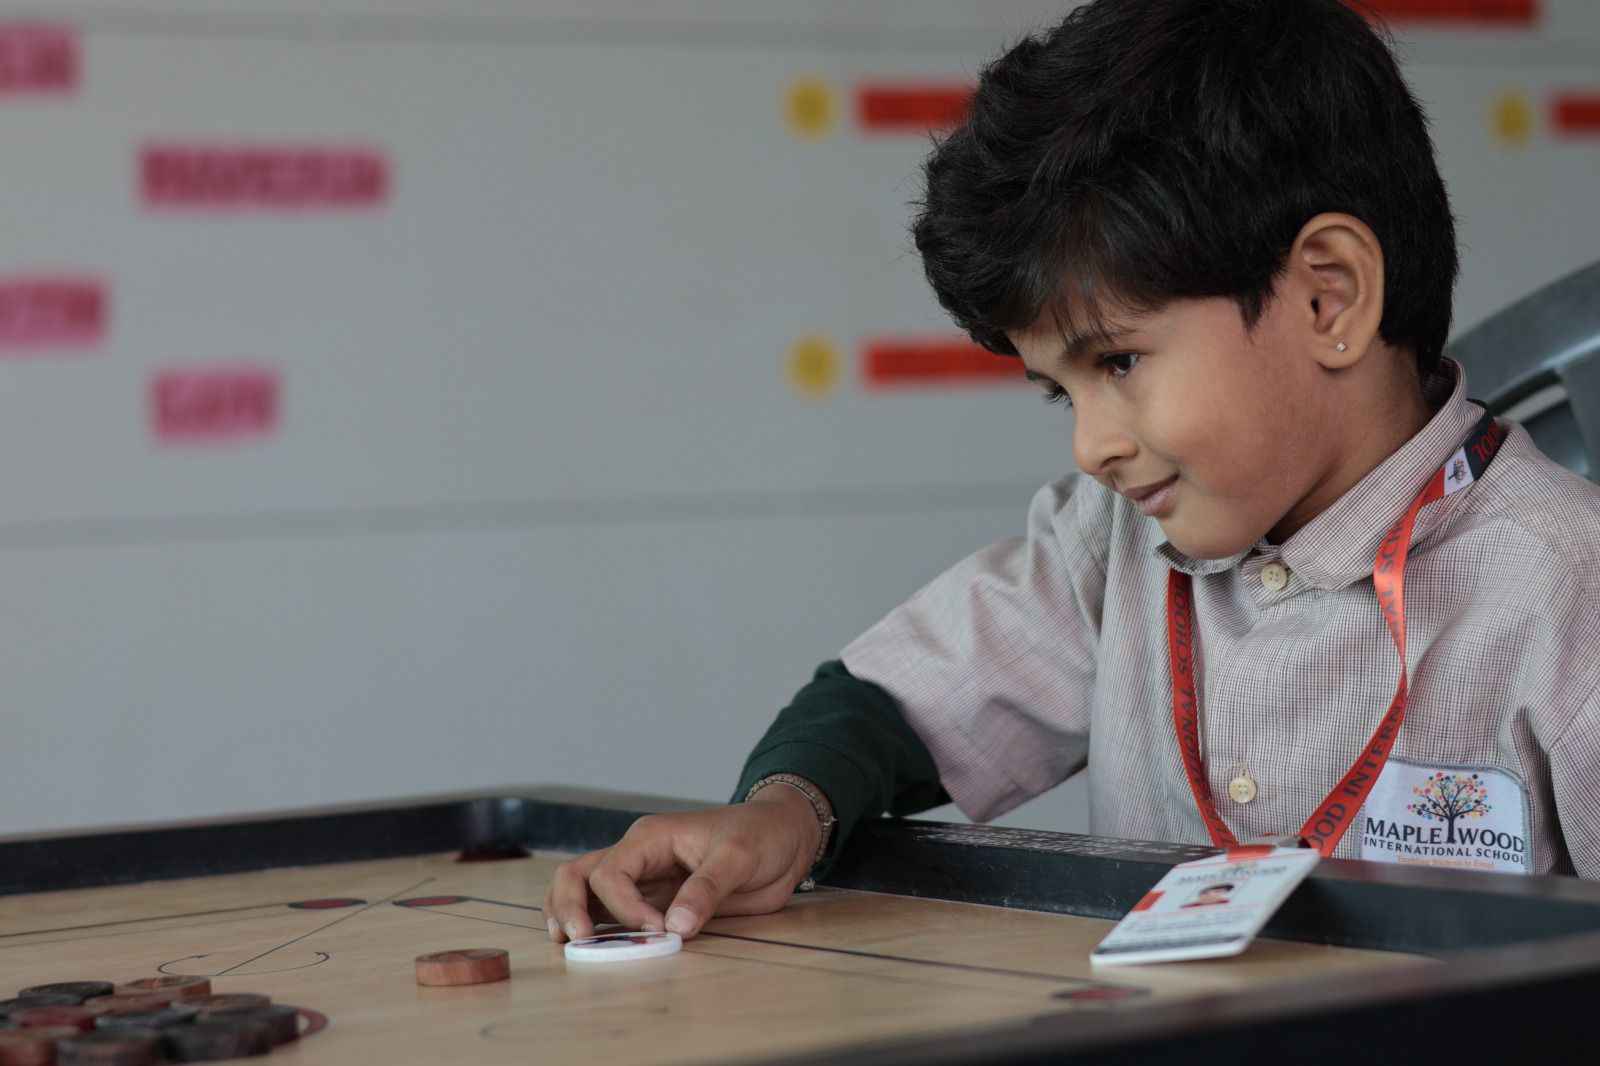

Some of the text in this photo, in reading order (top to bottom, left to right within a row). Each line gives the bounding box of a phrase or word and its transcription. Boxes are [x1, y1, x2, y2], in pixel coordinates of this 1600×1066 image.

[1364, 836, 1526, 865] INTERNATIONAL SCHOOL
[1365, 817, 1525, 853] MAPLE WOOD
